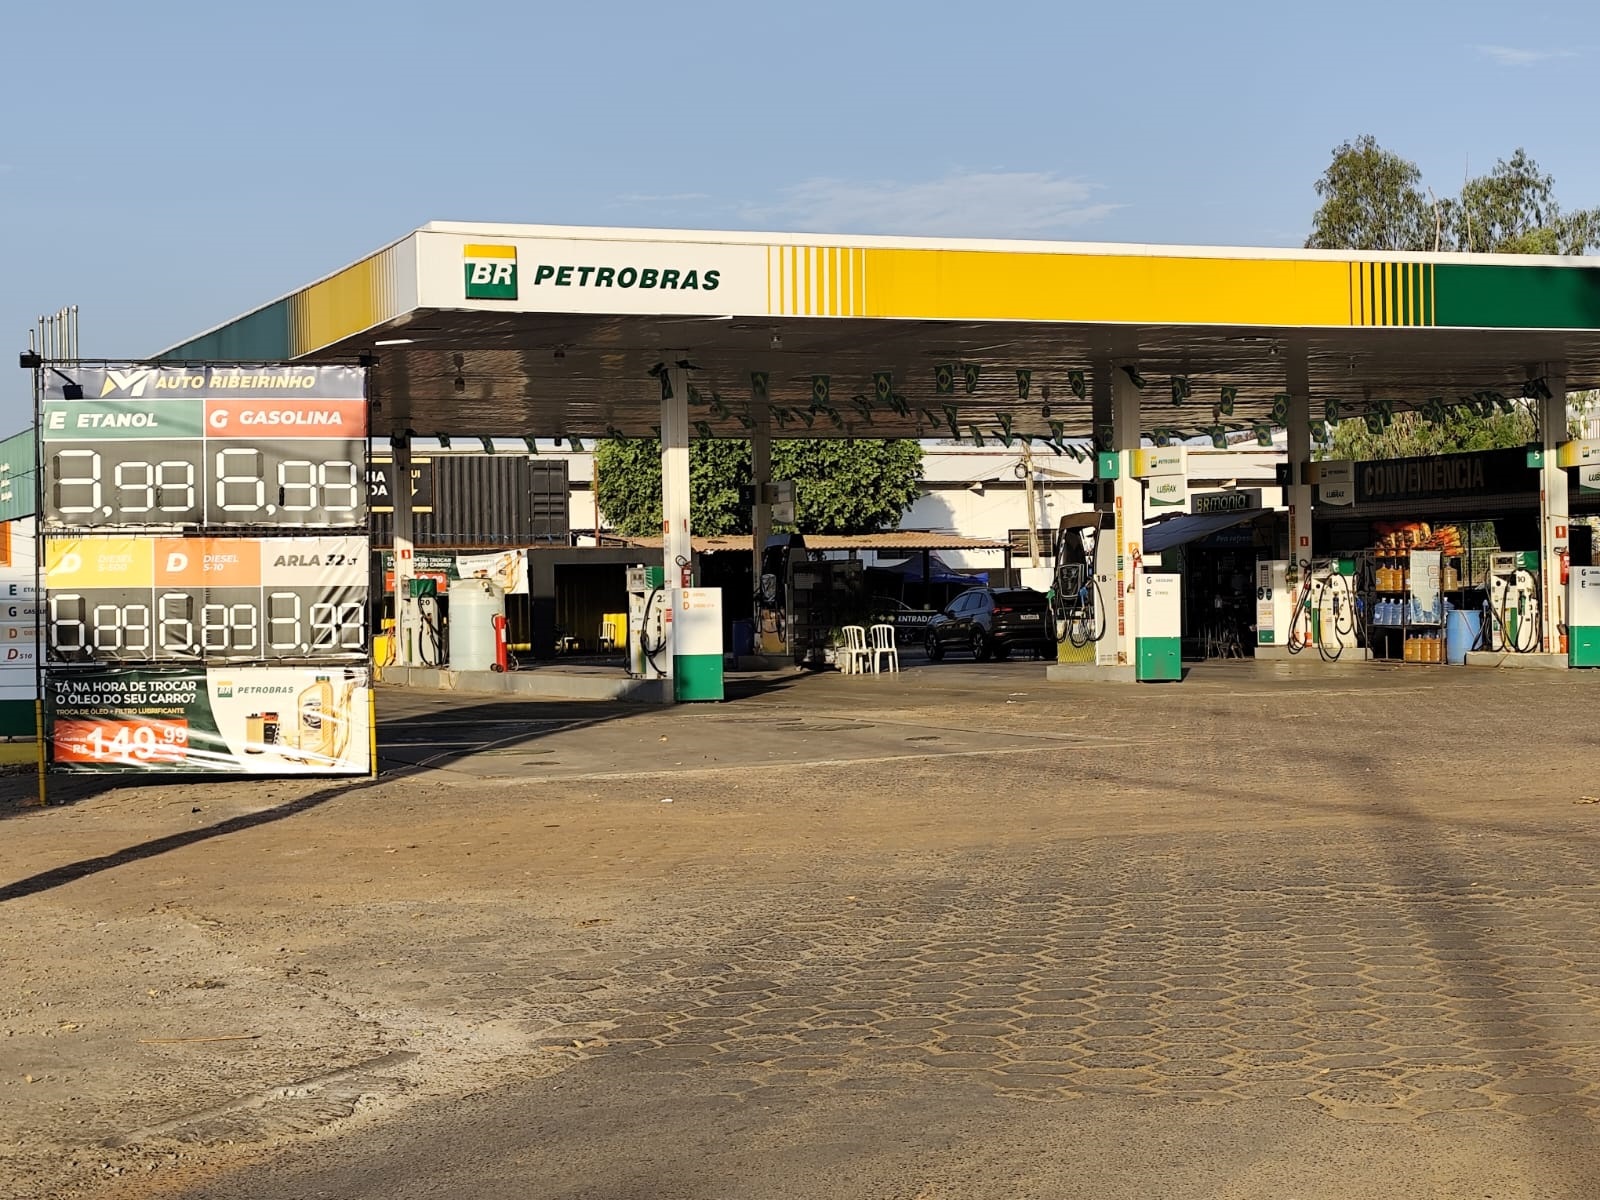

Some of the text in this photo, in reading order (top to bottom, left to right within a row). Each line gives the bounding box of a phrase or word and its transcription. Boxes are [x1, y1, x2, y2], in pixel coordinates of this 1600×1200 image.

[470, 263, 721, 291] BR PETROBRAS
[154, 375, 316, 389] AUTO RIBEIRINHO
[49, 411, 158, 429] E ETANOL
[209, 409, 342, 429] G GASOLINA
[1107, 460, 1112, 470] 1
[56, 449, 195, 518] 3,99
[166, 552, 188, 572] D
[203, 555, 239, 563] DIESEL
[273, 555, 321, 567] ARLA
[325, 554, 345, 566] 32
[203, 563, 224, 571] S-10
[9, 584, 17, 596] E
[8, 606, 17, 617] G
[8, 649, 19, 660] D
[55, 681, 197, 692] TÁ NA HORA DE TROCAR
[237, 686, 294, 694] PETROBRAS
[56, 692, 196, 705] O ÓLEO DO SEU CARRO?
